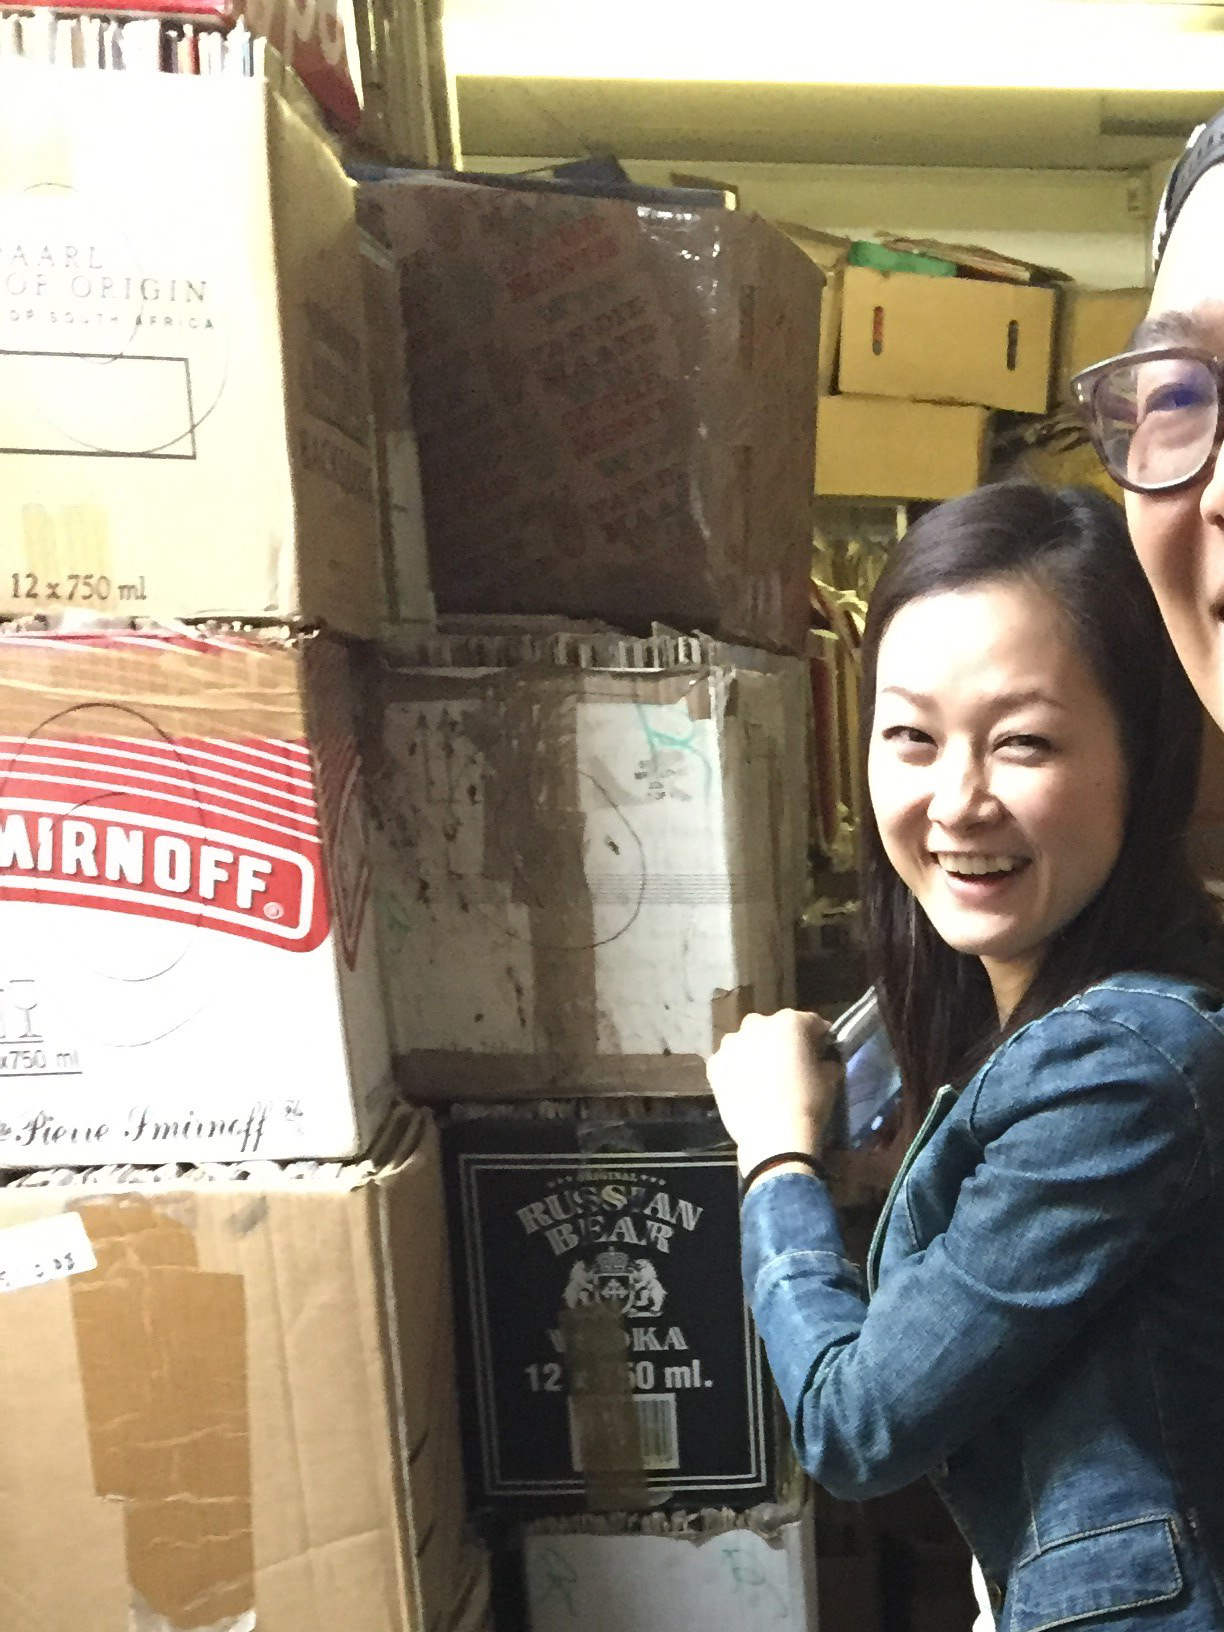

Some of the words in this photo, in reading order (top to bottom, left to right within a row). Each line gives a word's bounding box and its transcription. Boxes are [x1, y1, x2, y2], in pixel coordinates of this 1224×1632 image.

[0, 243, 103, 269] AARL
[70, 275, 208, 303] ORIGIN
[133, 314, 215, 331] AFRICA
[0, 813, 273, 910] MIRNOFF
[545, 1214, 676, 1257] BEAR
[524, 1366, 563, 1392] 12
